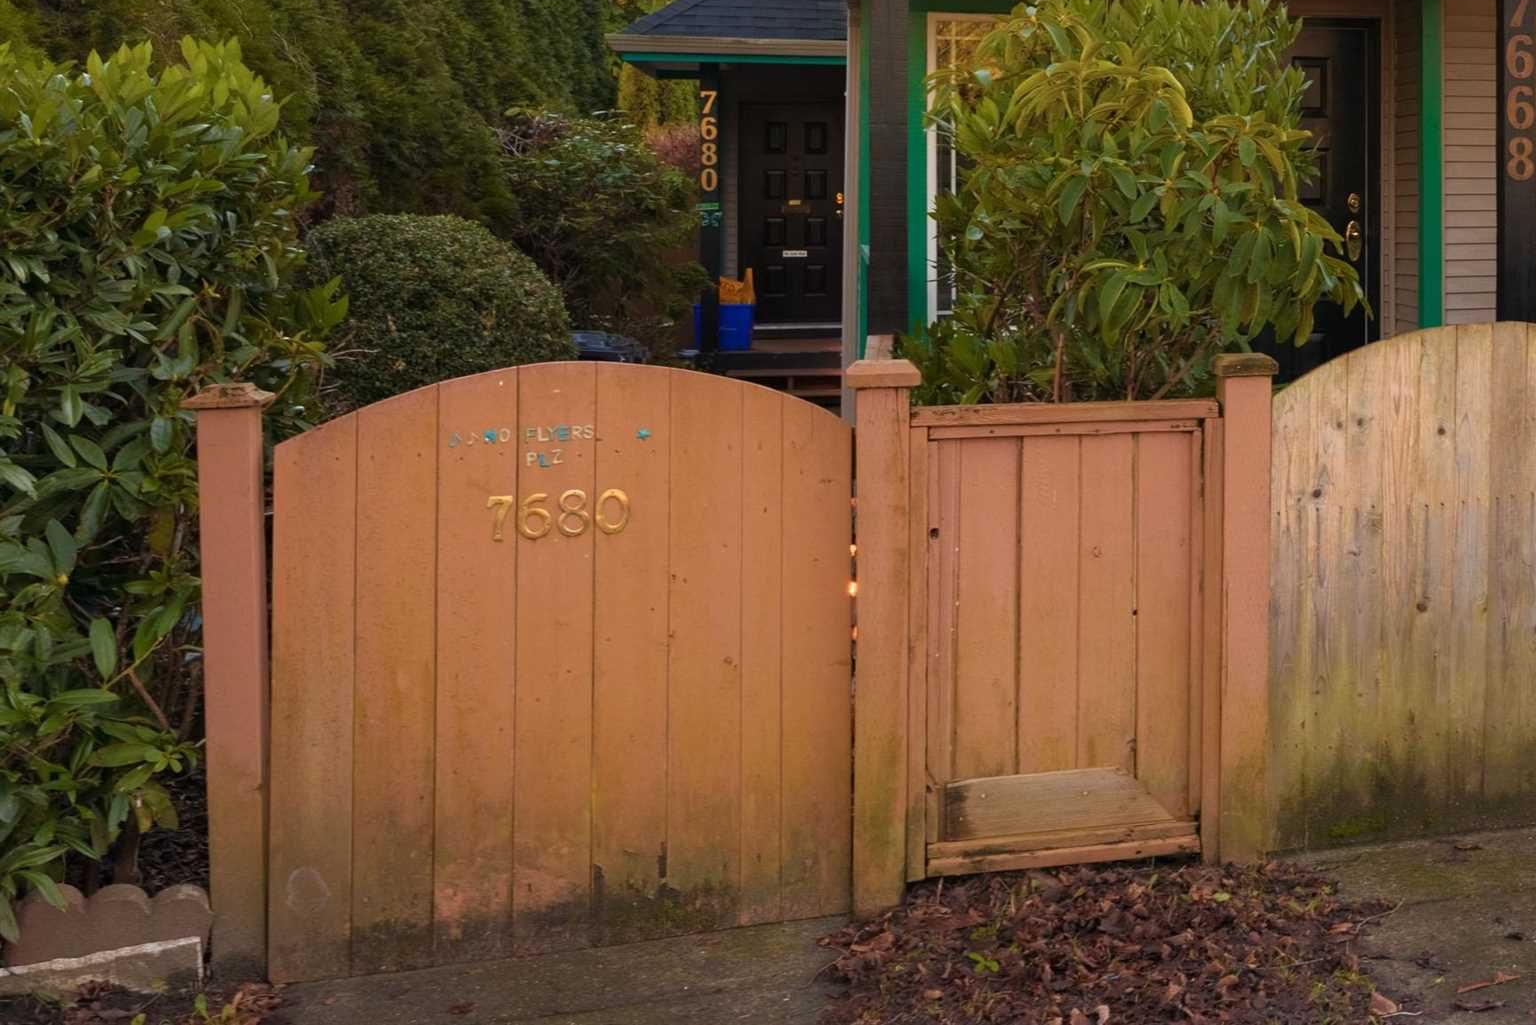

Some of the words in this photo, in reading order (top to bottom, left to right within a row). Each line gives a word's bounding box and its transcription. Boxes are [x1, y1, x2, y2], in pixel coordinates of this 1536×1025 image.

[700, 90, 718, 192] 7680
[524, 424, 594, 442] FLYERS
[526, 448, 564, 469] PLZ
[486, 488, 631, 543] 7680
